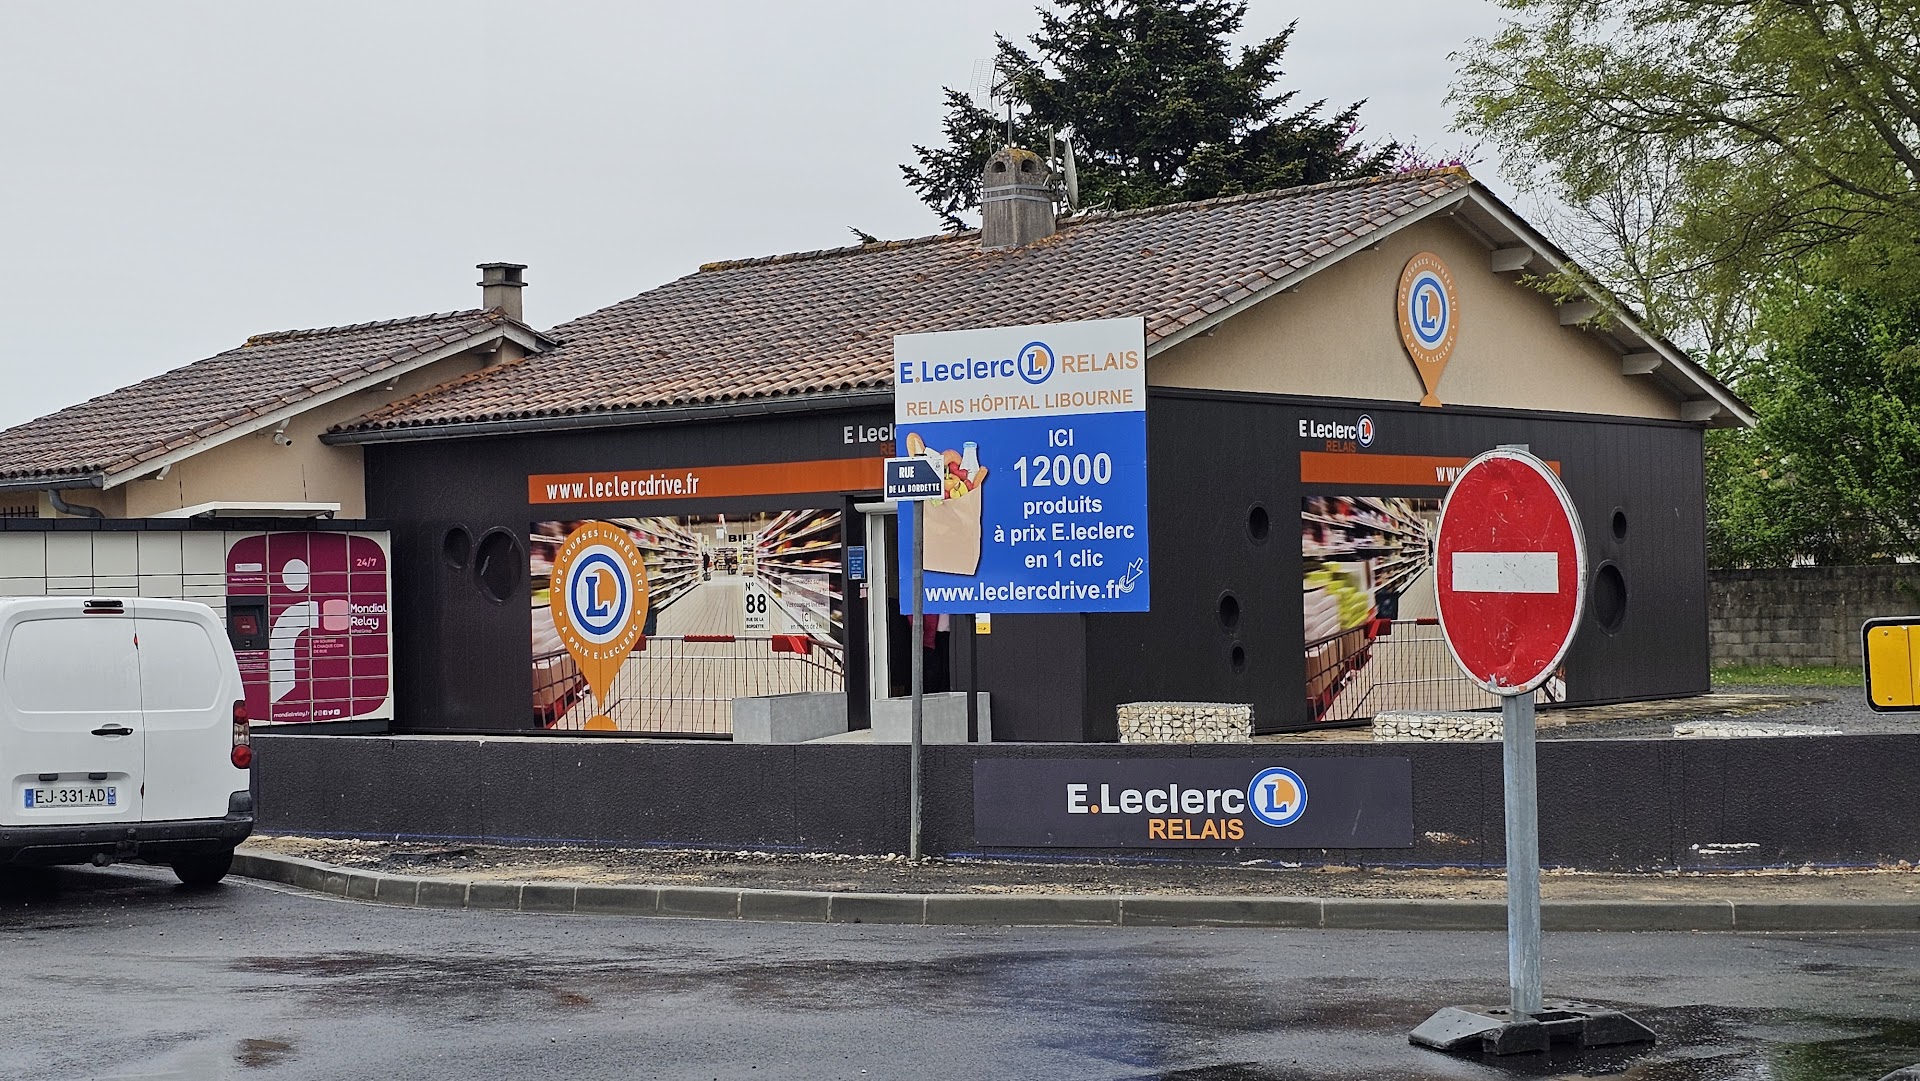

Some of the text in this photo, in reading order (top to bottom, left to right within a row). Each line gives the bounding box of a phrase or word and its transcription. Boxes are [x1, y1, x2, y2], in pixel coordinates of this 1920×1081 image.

[1405, 258, 1429, 282] COURSES
[1410, 342, 1424, 360] PRIX
[1426, 335, 1453, 363] E.LECLERC
[900, 358, 1014, 383] E.Leclerc
[1061, 351, 1138, 373] RELAIS
[906, 389, 1133, 416] RELAIS HÔPITAL LIBOURNE
[1048, 428, 1074, 447] ICI
[1326, 440, 1356, 452] RELAIS
[899, 466, 914, 478] RUE
[1013, 453, 1112, 487] 12000
[546, 473, 700, 499] www.leclercdrive.fr
[889, 483, 940, 494] DE LA BORDETTE
[1023, 496, 1102, 519] produits
[994, 522, 1135, 546] à prix E.leclerc
[356, 557, 377, 567] 24/7
[555, 529, 644, 593] VOS COURSES LIVRÉES ICI
[1024, 549, 1104, 568] en 1 clic
[745, 582, 754, 591] N°
[925, 580, 1120, 601] www.leclercdrive.fr
[350, 603, 386, 613] Mondial
[746, 594, 766, 613] 88
[350, 616, 379, 630] Relay
[568, 636, 589, 657] PRIX
[593, 624, 638, 660] E.LECLERC
[274, 710, 310, 718] mondialrelay.fr
[35, 789, 105, 804] EJ-331-AD
[1067, 784, 1245, 814] E.Leclerc
[1149, 819, 1245, 840] RELAIS
